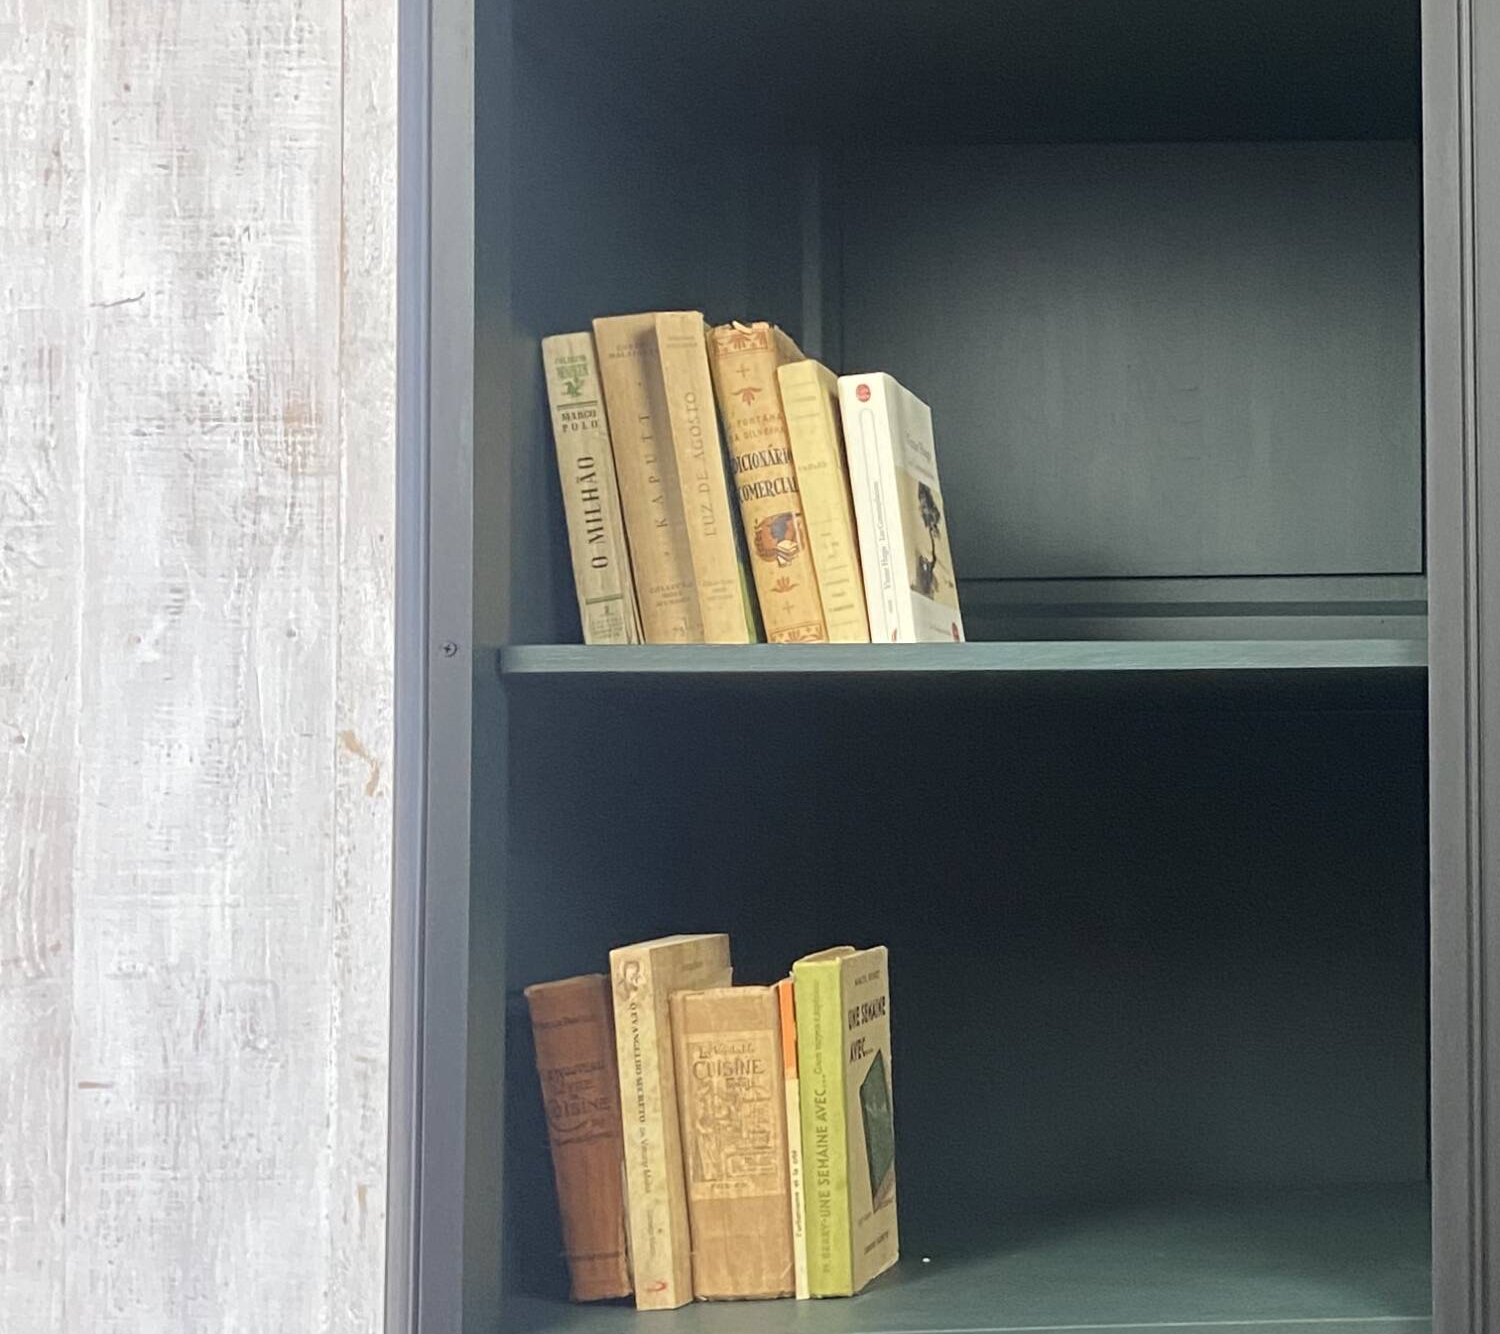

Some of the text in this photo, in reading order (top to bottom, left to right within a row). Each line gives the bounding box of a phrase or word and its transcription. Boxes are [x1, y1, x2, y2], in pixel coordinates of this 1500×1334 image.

[562, 420, 599, 433] POLO
[684, 391, 717, 537] LUZ DE AGOSTO
[577, 456, 609, 569] O MILHÃO
[638, 415, 668, 529] KAPUTT
[693, 1056, 766, 1081] CUISINE
[816, 1125, 831, 1187] SEMAINE
